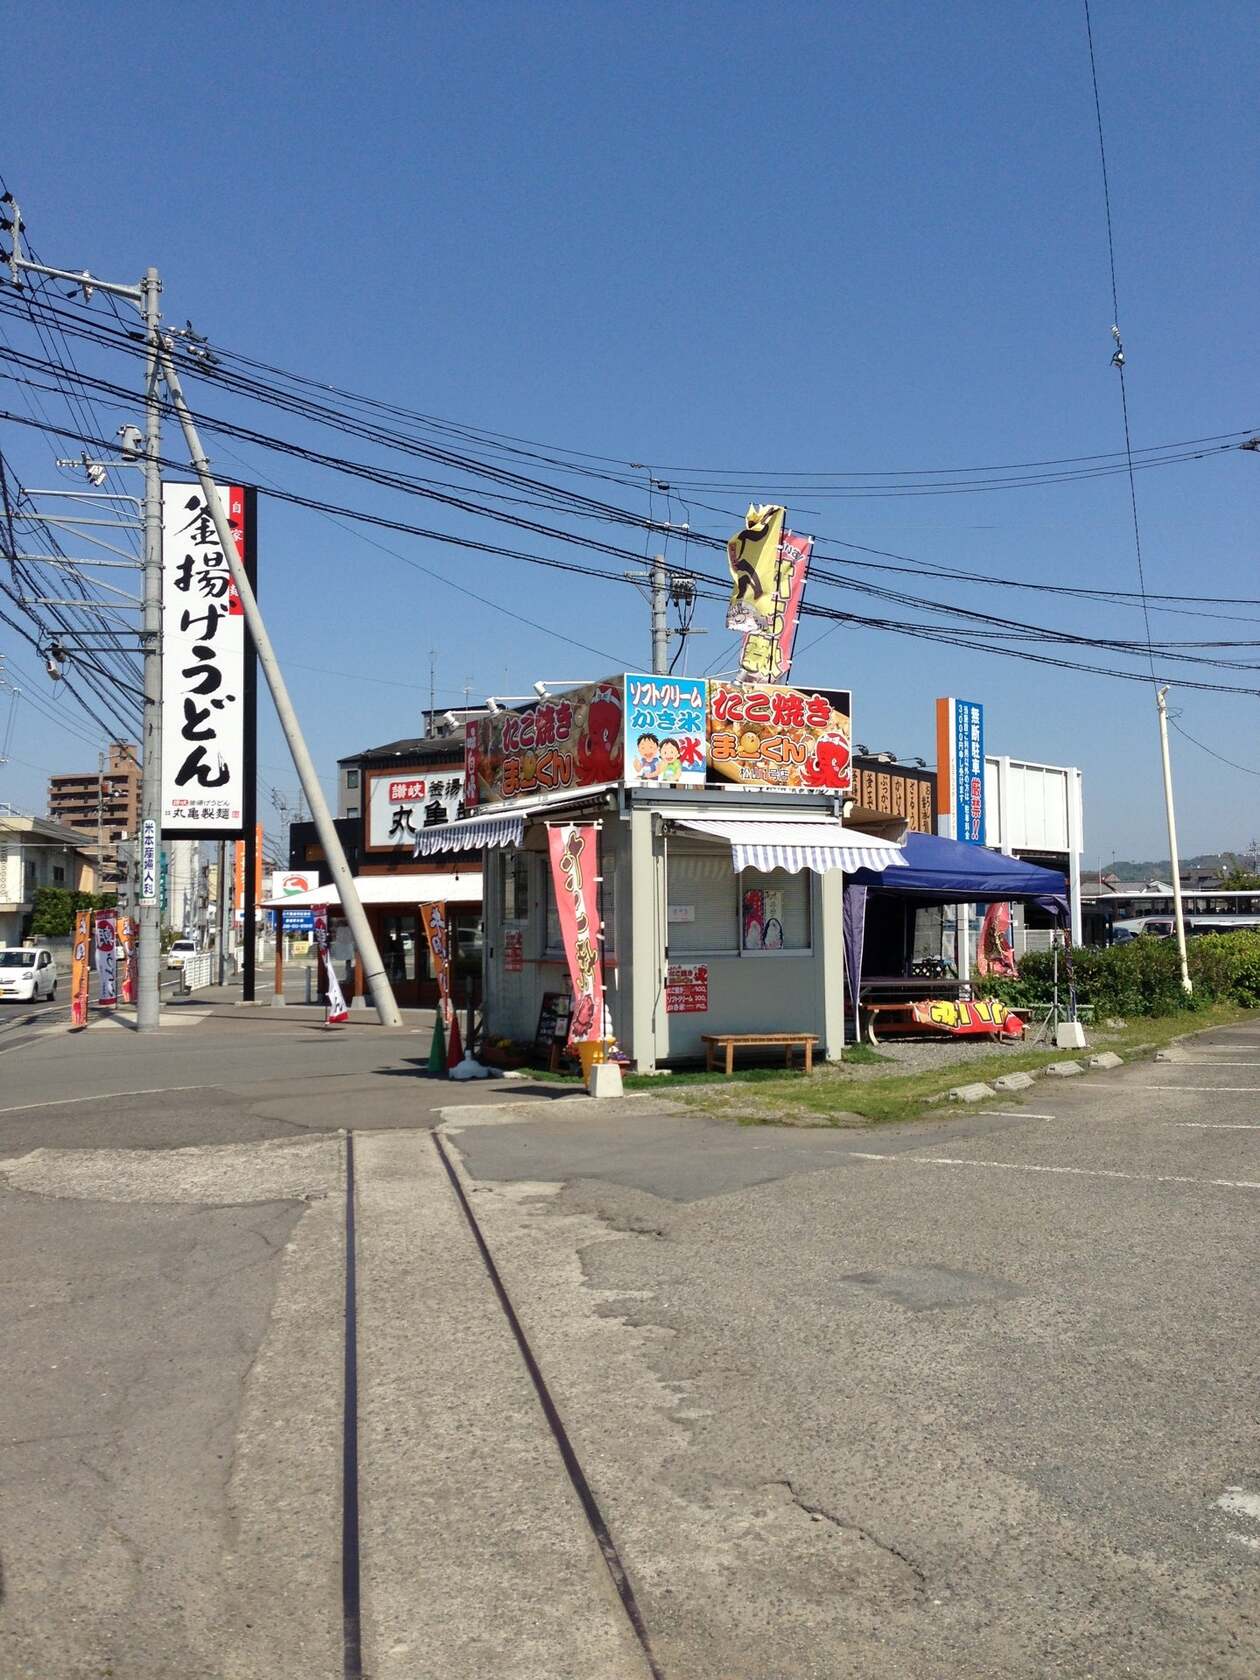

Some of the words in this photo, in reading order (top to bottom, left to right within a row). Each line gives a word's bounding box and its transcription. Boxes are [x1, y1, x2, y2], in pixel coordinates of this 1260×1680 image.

[173, 495, 239, 788] 釜揚げうどん
[630, 681, 703, 708] ソフトクリーム
[711, 687, 832, 728] たこ焼き
[502, 698, 573, 755] たこ焼き
[631, 708, 702, 733] かき氷
[391, 784, 424, 799] 讃岐
[172, 807, 231, 820] 丸亀製麺
